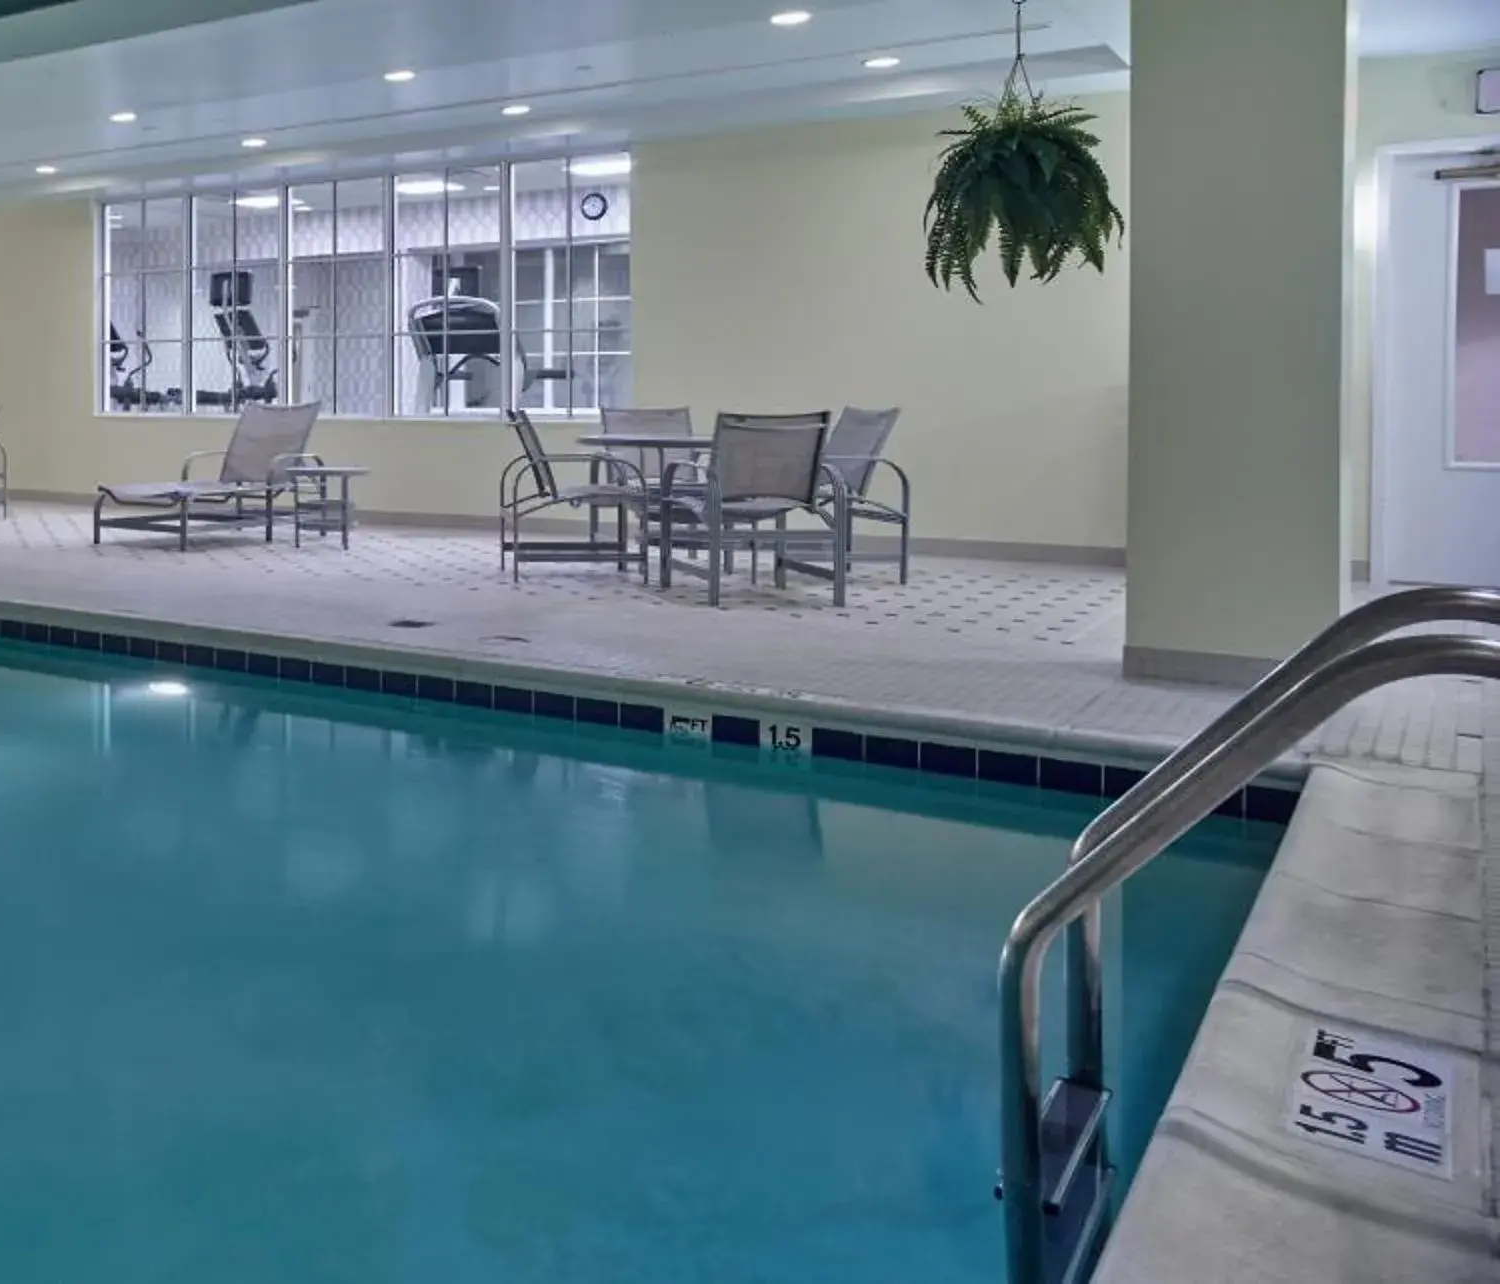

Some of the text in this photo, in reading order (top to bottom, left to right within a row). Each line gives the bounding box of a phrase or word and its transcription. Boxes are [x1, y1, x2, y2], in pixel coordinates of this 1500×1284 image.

[768, 725, 801, 749] 1.5
[1295, 1103, 1369, 1145] 1.5
[1383, 1131, 1442, 1165] m
